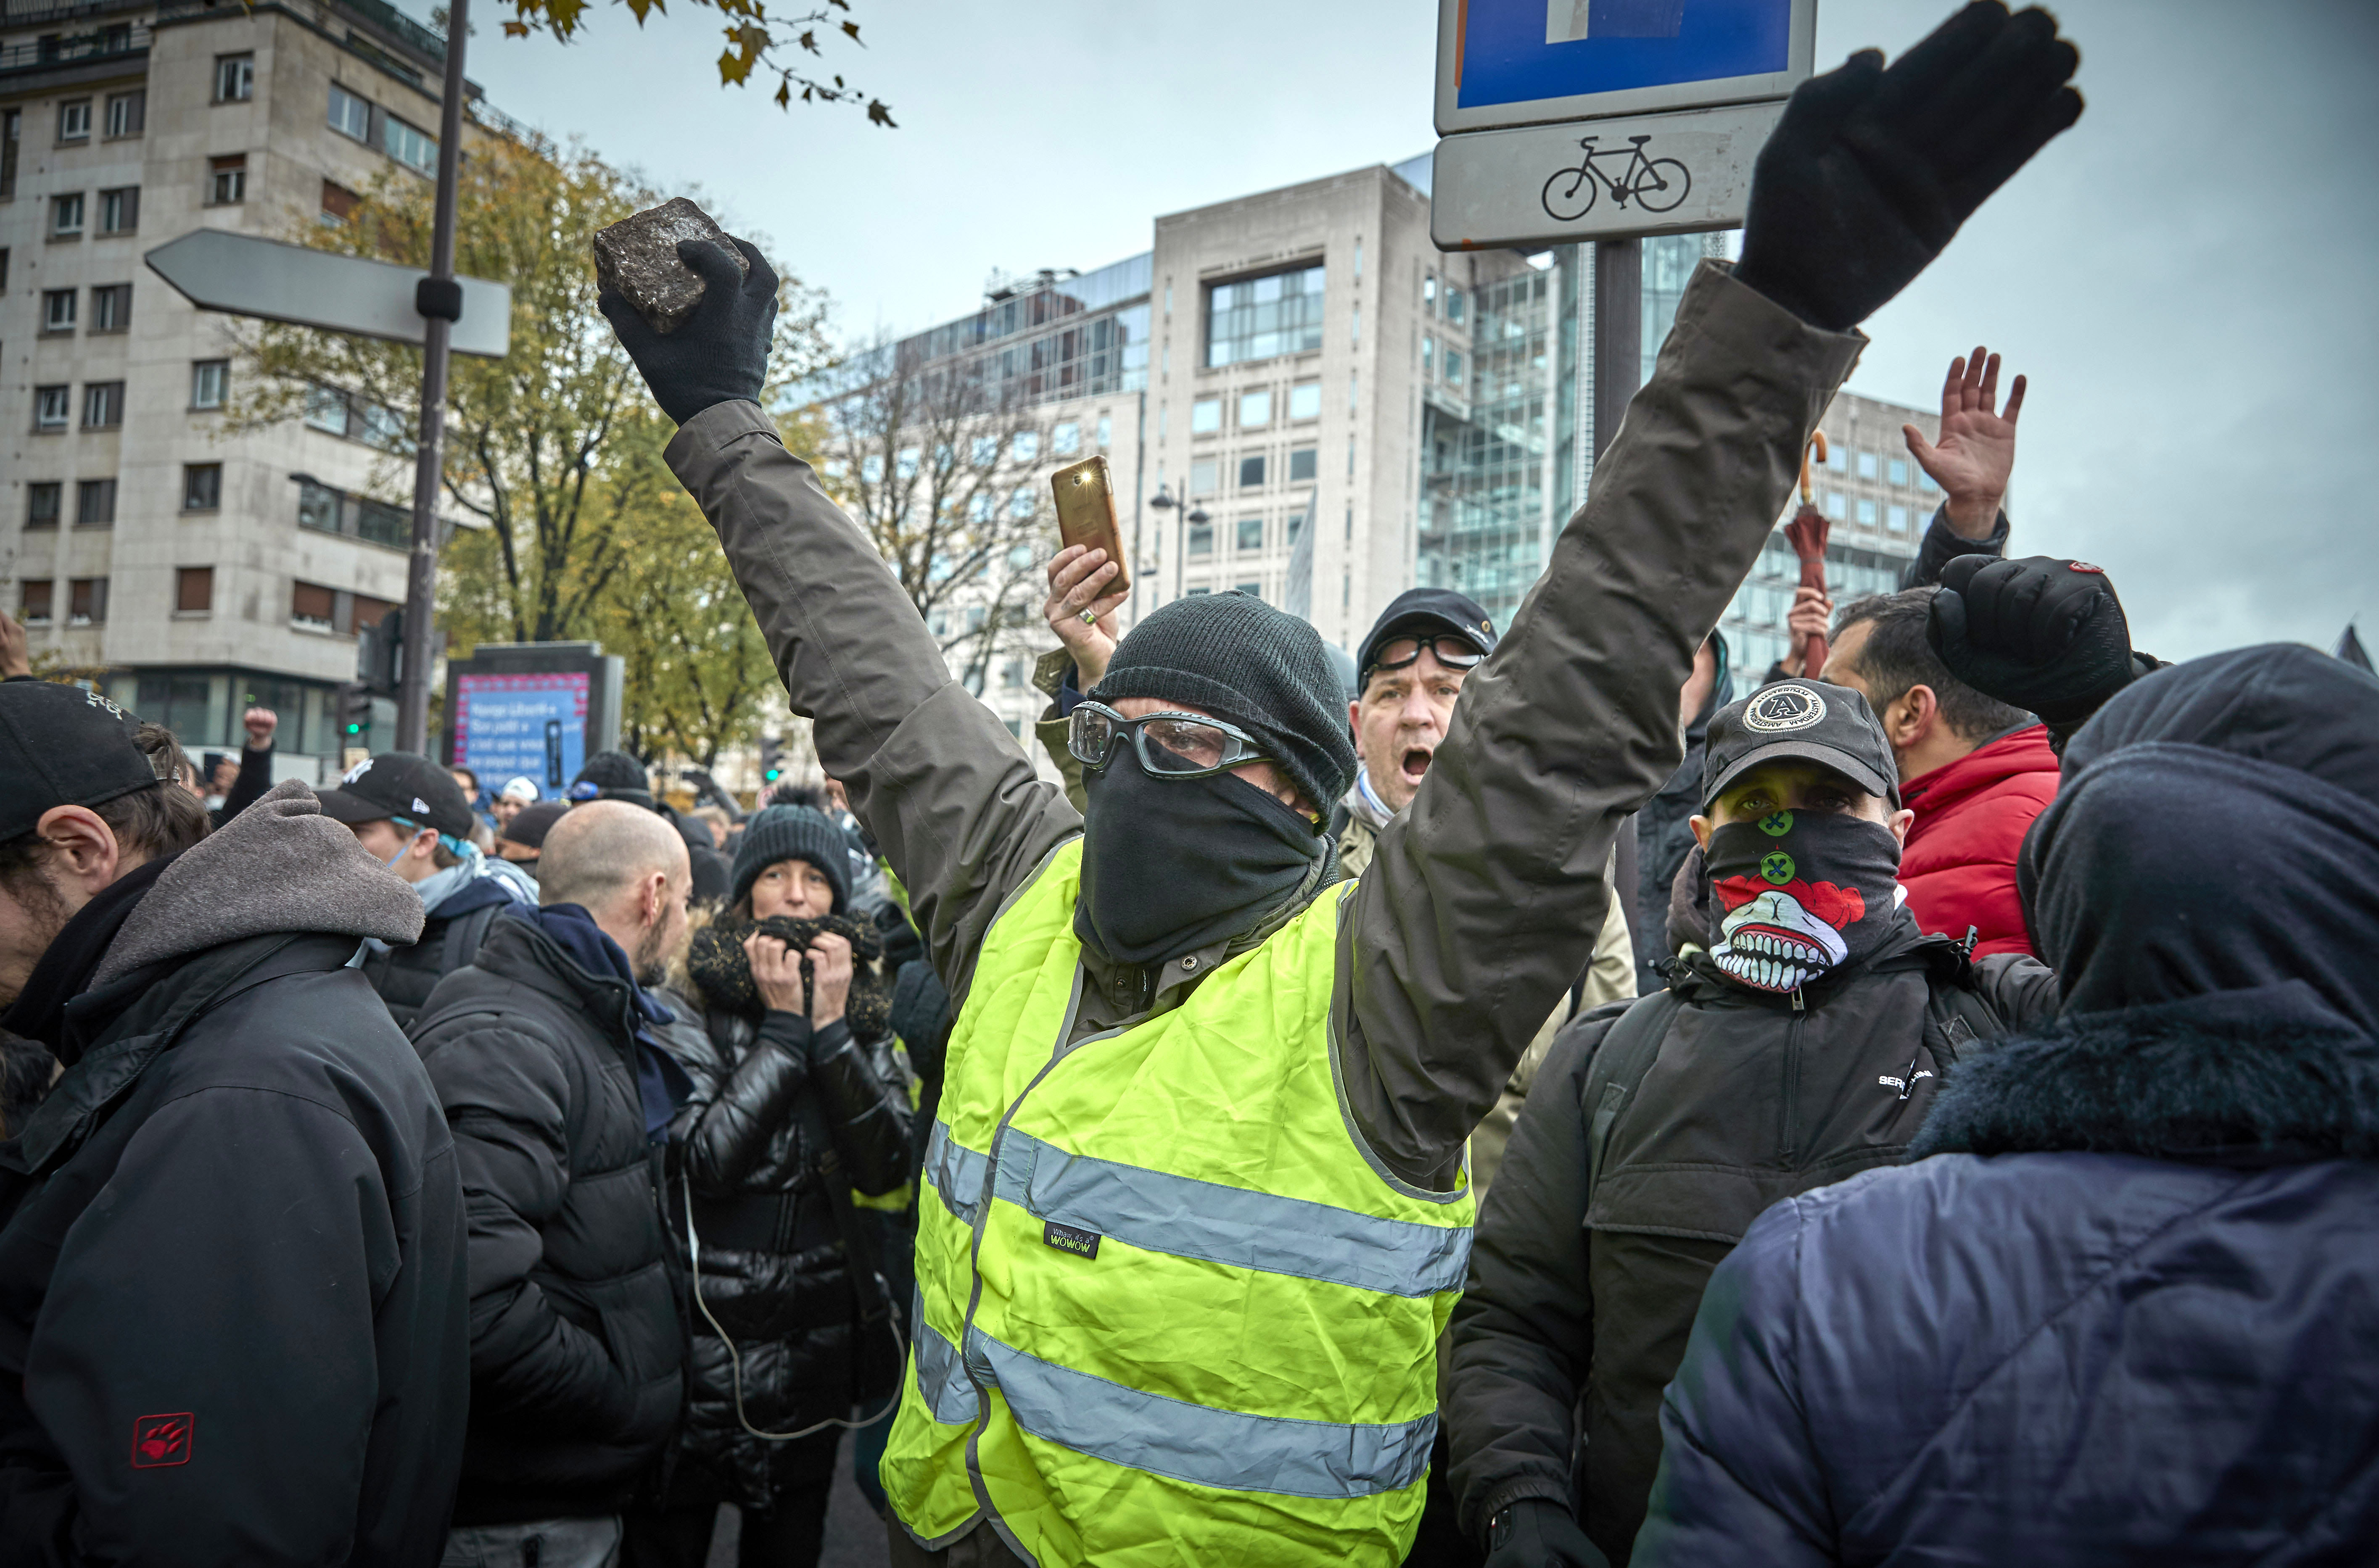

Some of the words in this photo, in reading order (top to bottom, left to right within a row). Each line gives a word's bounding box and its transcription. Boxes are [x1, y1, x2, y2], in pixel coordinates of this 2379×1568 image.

[1757, 687, 1809, 703] AMSTERDAM
[1765, 695, 1803, 719] A
[1789, 698, 1819, 726] AMSTERDAM
[1750, 707, 1782, 727] AMSTERDAM
[1051, 1234, 1090, 1253] WOWOW
[1053, 1228, 1072, 1240] Whaw,
